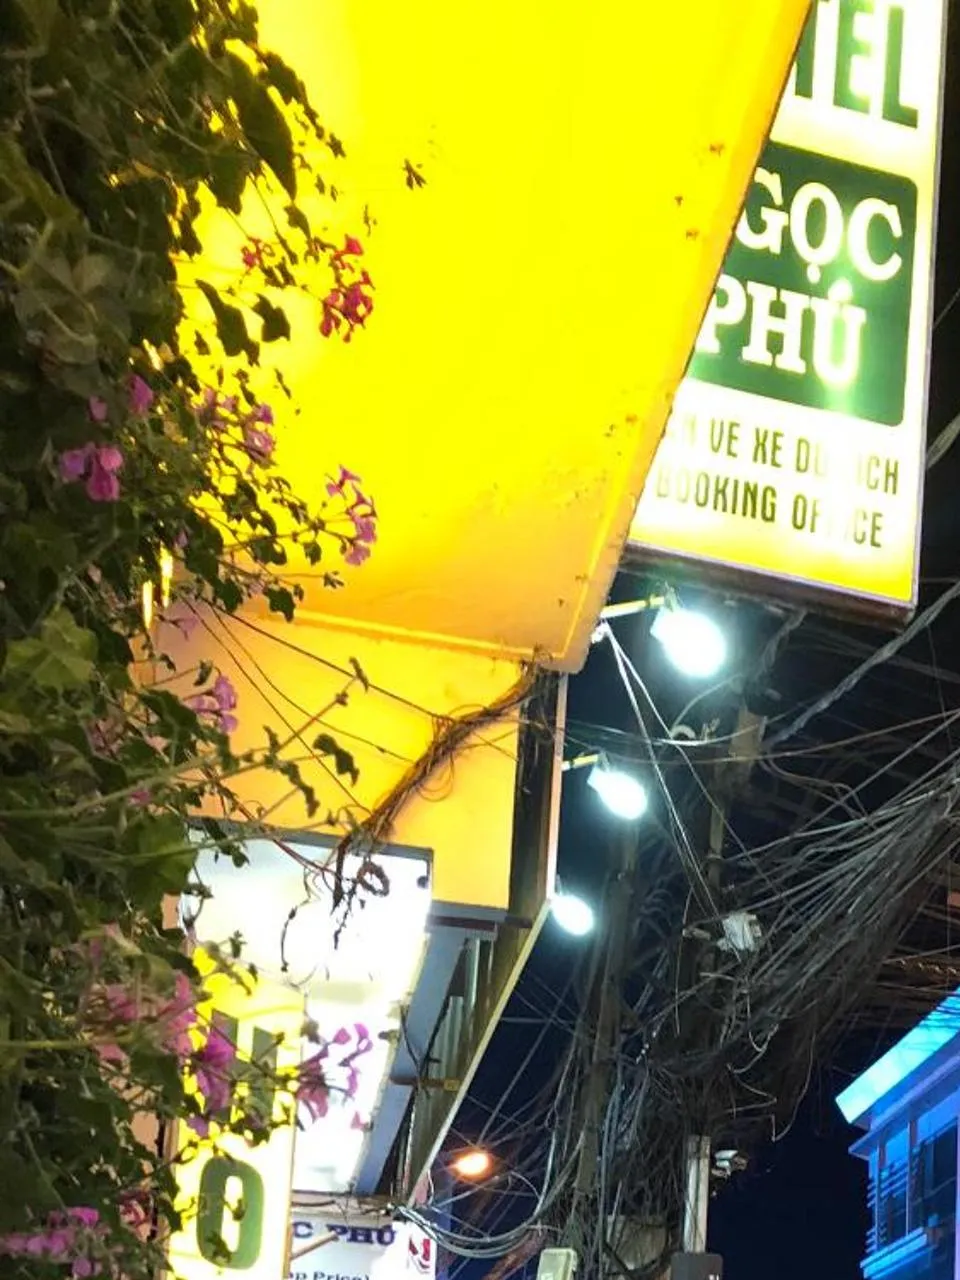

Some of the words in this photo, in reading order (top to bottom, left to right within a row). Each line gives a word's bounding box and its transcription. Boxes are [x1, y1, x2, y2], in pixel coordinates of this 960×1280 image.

[736, 167, 903, 284] GỌC
[753, 427, 785, 468] XE
[656, 465, 777, 523] BOOKING
[791, 493, 884, 548] OFCE
